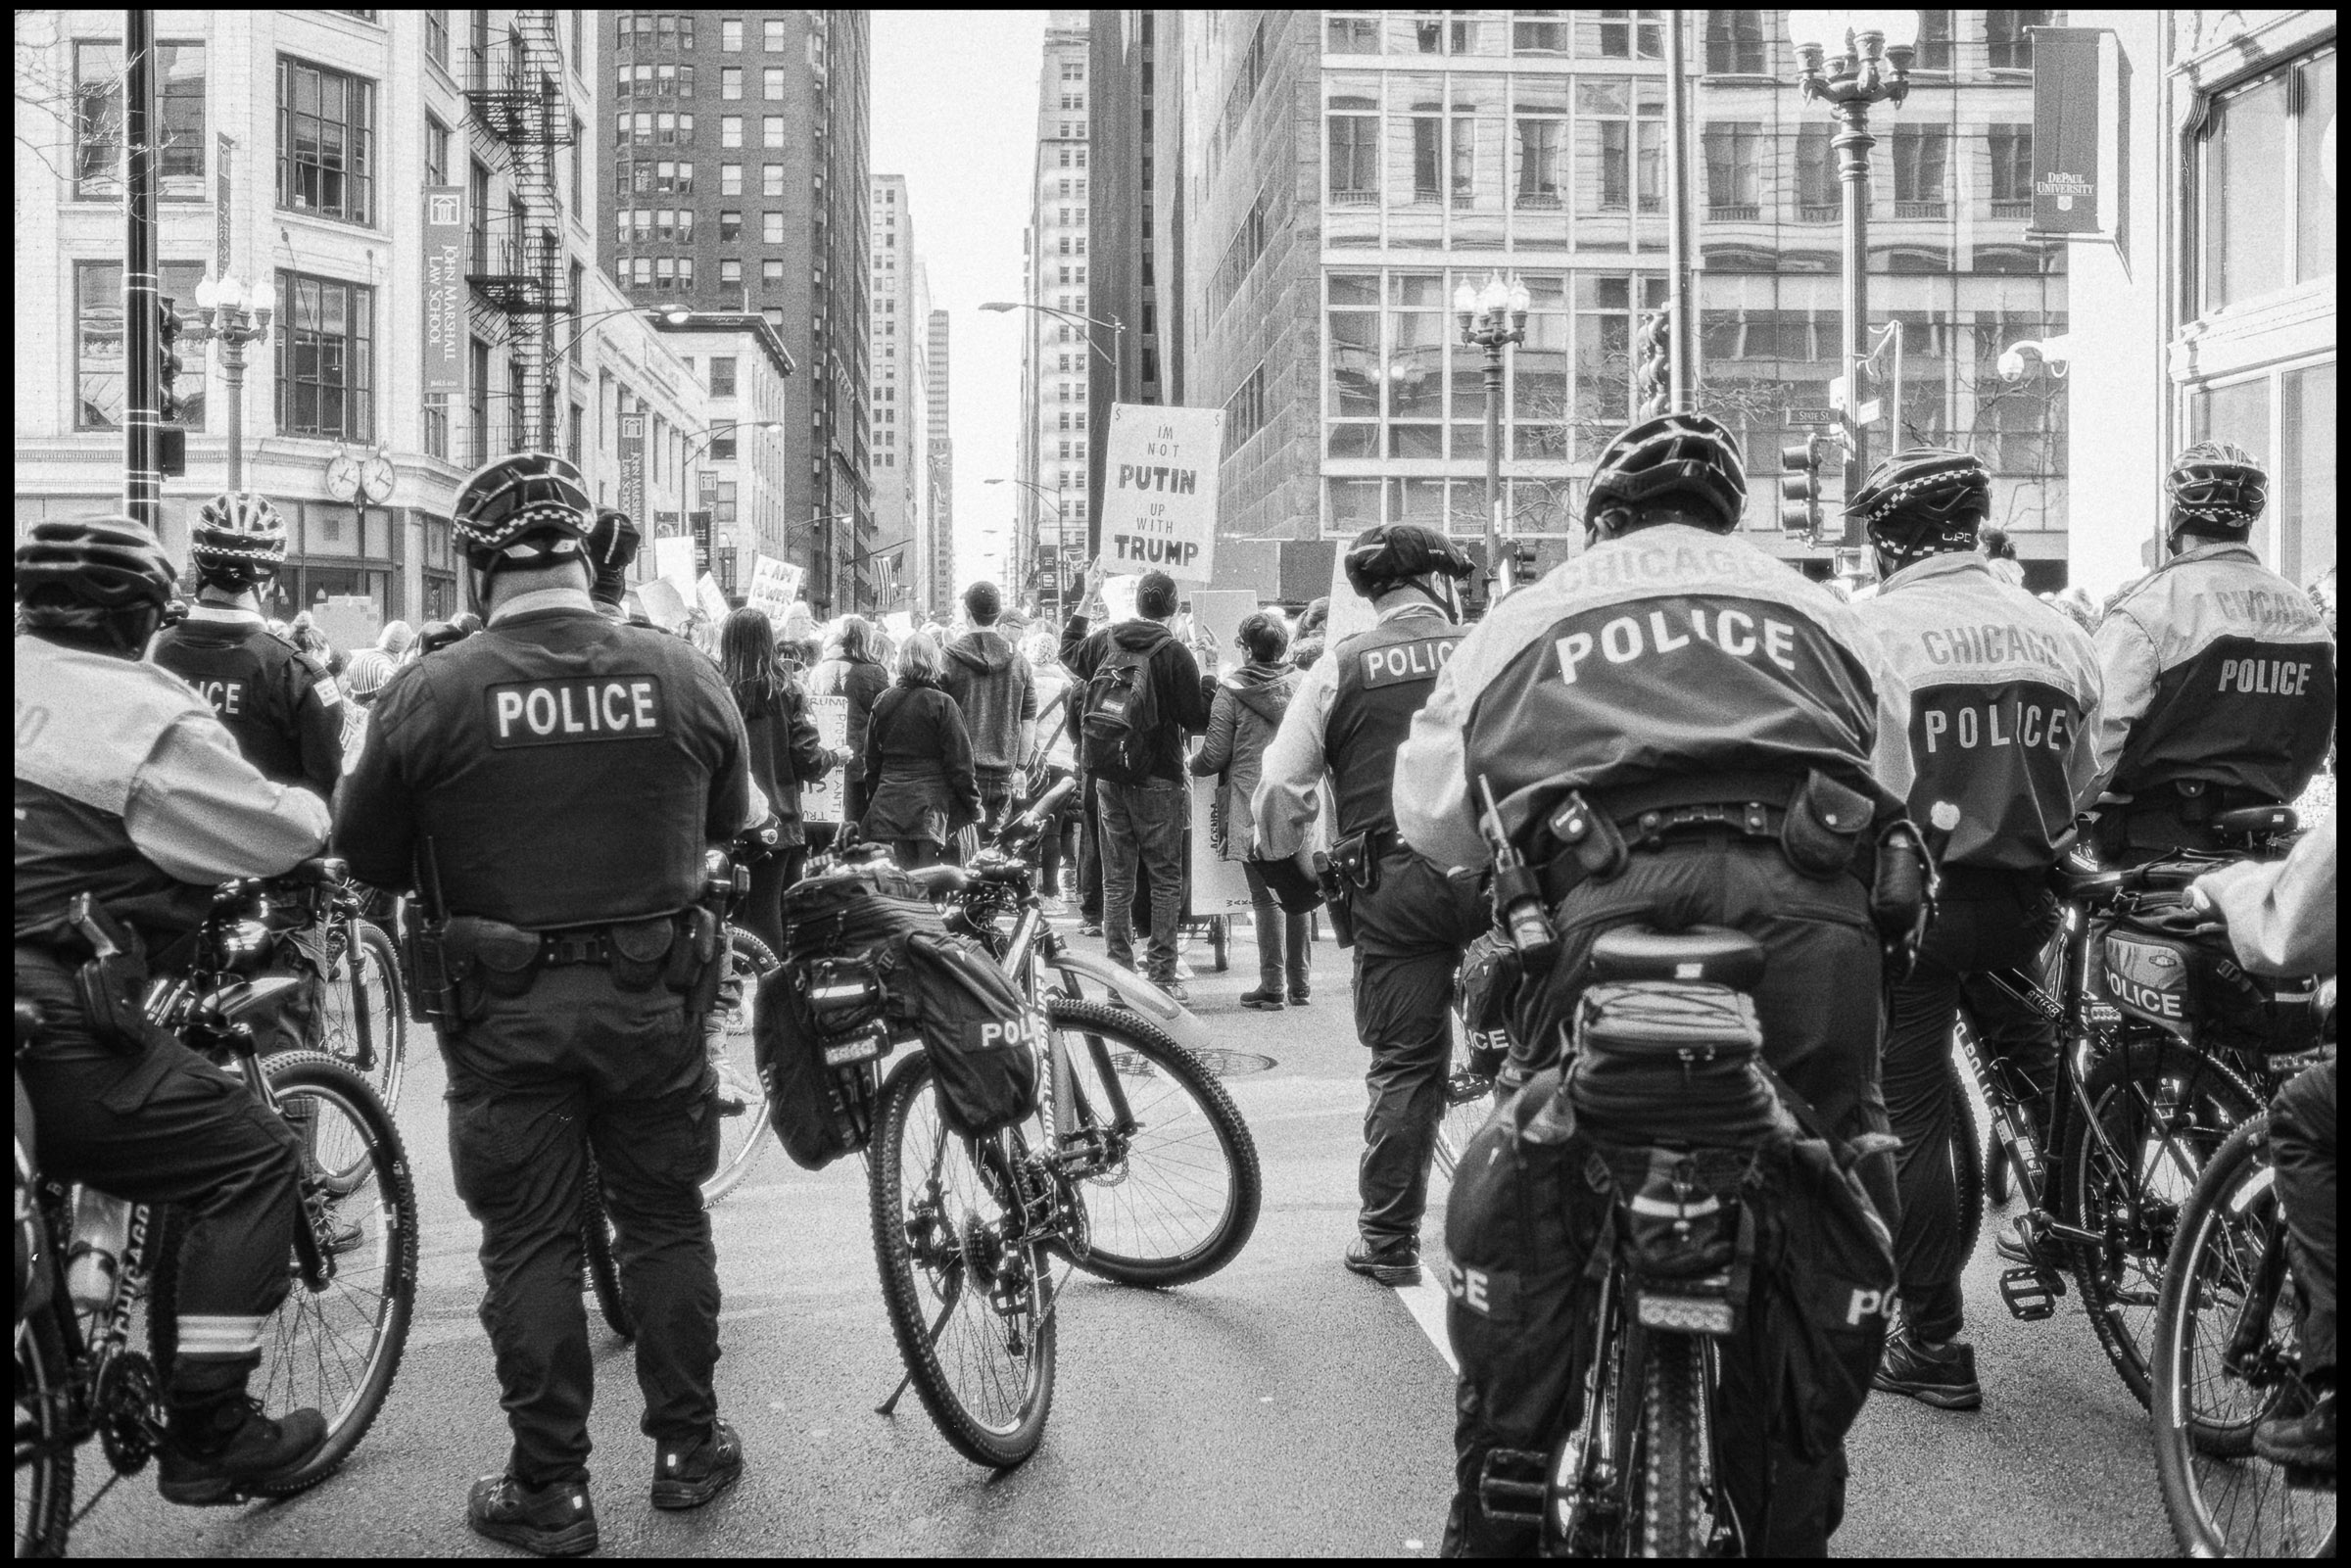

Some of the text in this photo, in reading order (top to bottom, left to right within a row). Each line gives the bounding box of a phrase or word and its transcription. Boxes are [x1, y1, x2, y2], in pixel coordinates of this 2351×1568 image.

[2037, 181, 2094, 194] UNIVERSITY
[441, 245, 458, 281] JOHN
[429, 256, 444, 347] LAW SCHOOL
[444, 285, 458, 362] MARSHALL
[1147, 443, 1179, 458] NOT
[1119, 463, 1197, 496] PUTIN
[1136, 517, 1174, 534] WITH
[1150, 502, 1166, 516] UP
[1114, 534, 1199, 567] TRUMP
[2215, 590, 2323, 624] CHICAGO
[1367, 640, 1454, 682] POLIC
[1555, 608, 1796, 686] POLICE
[1921, 624, 2061, 670] CHICAGO
[2218, 658, 2312, 695] POLICE
[184, 680, 242, 714] ICE
[497, 683, 657, 738] POLICE
[1925, 701, 2067, 753] POLICE
[2105, 966, 2183, 1018] OLICE
[981, 1017, 1033, 1048] POL
[1467, 1028, 1510, 1050] ICE
[110, 1204, 150, 1336] CHICAGO
